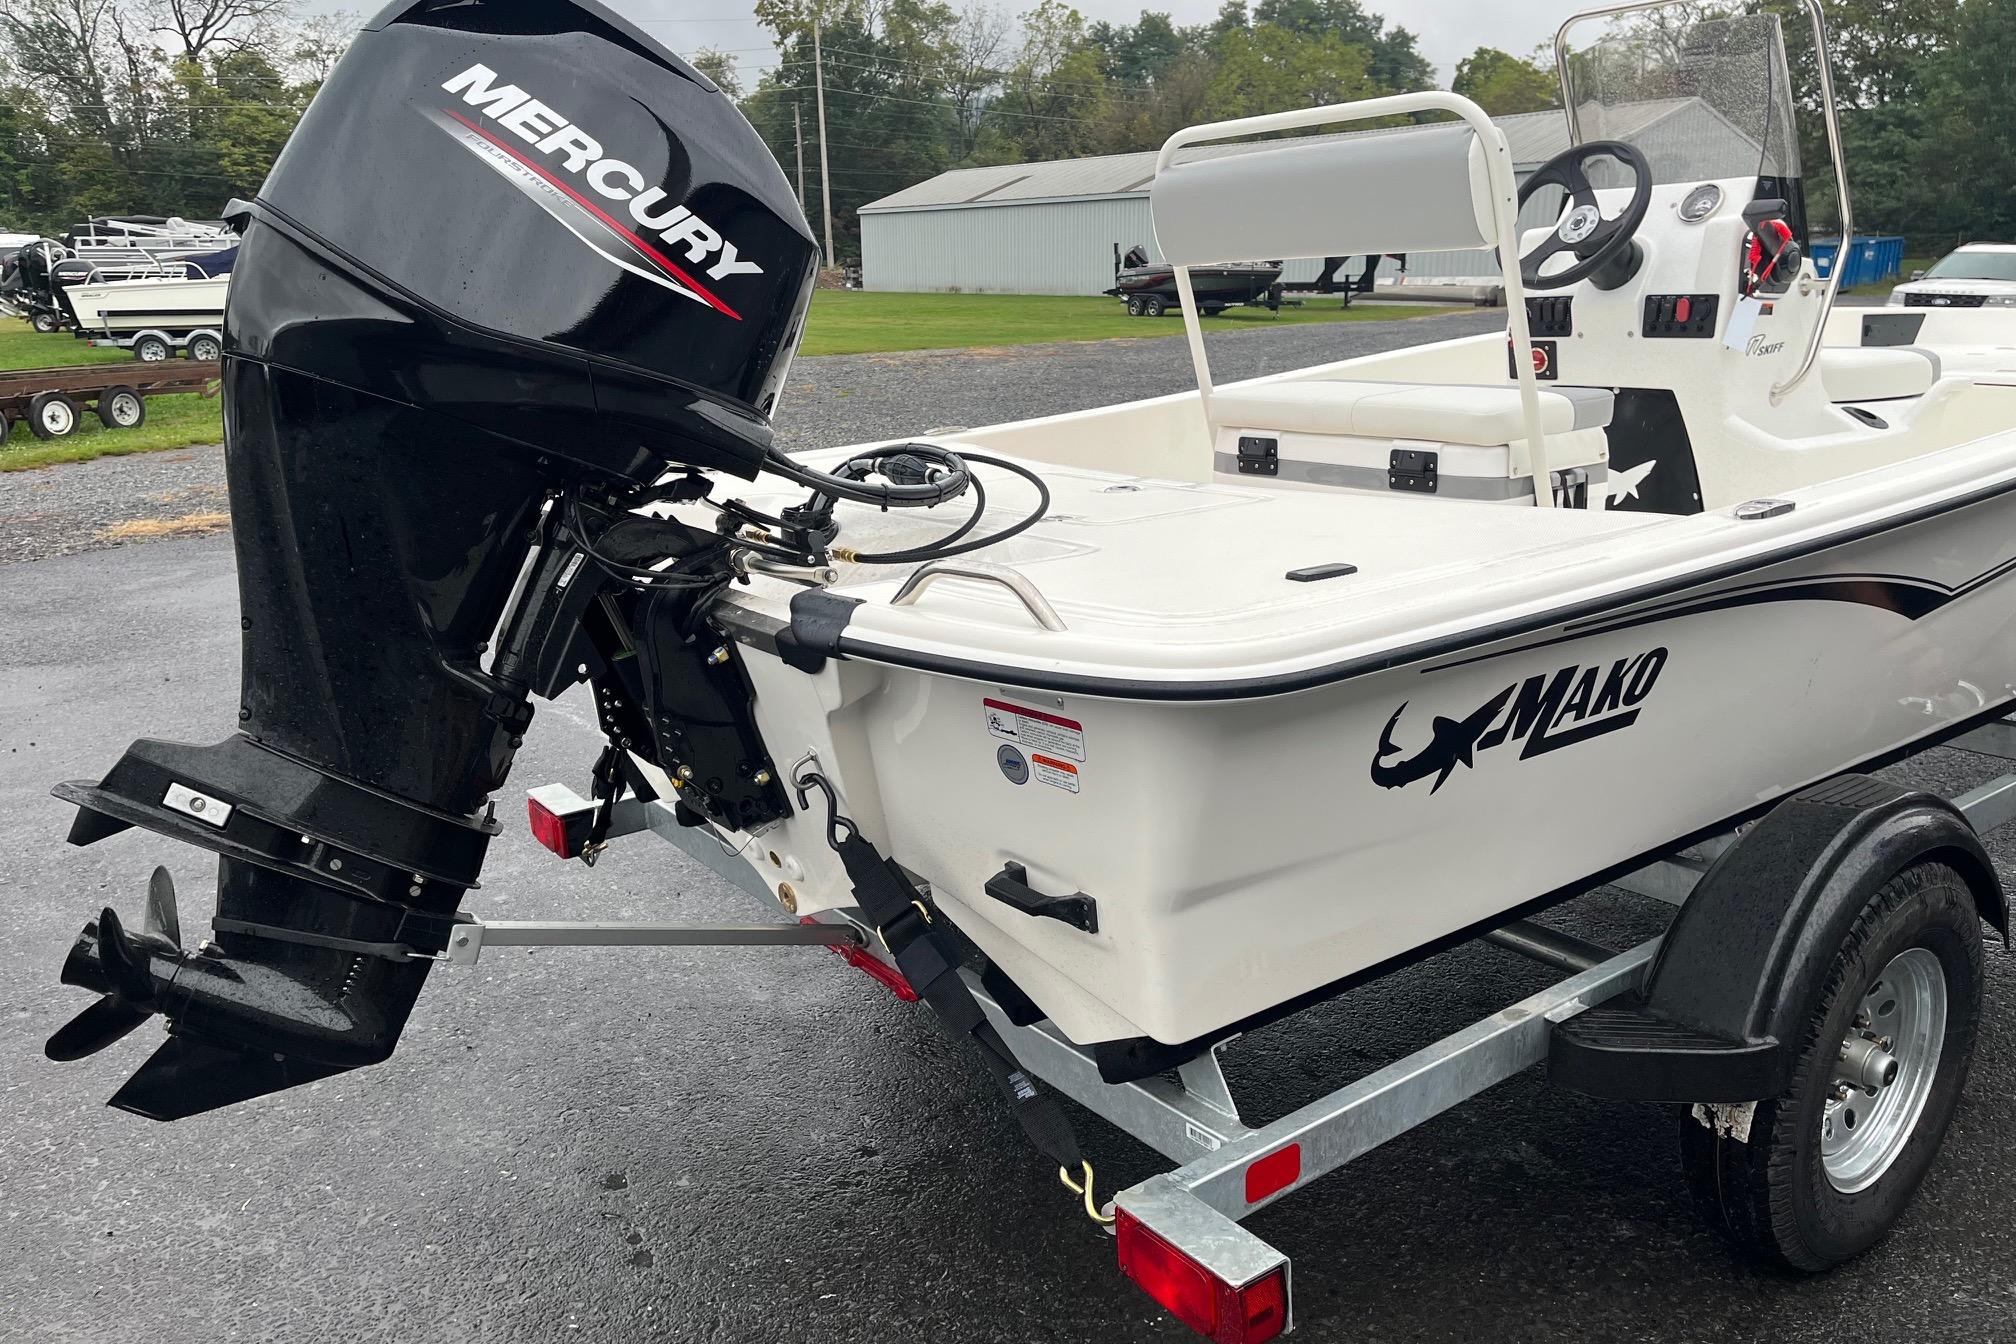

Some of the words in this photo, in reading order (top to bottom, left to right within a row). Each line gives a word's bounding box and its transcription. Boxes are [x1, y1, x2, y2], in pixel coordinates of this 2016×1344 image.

[441, 63, 764, 281] MERCURY
[465, 132, 577, 208] FOURSTROKE
[1757, 342, 1785, 356] SKIFF
[1477, 647, 1668, 761] MAKO
